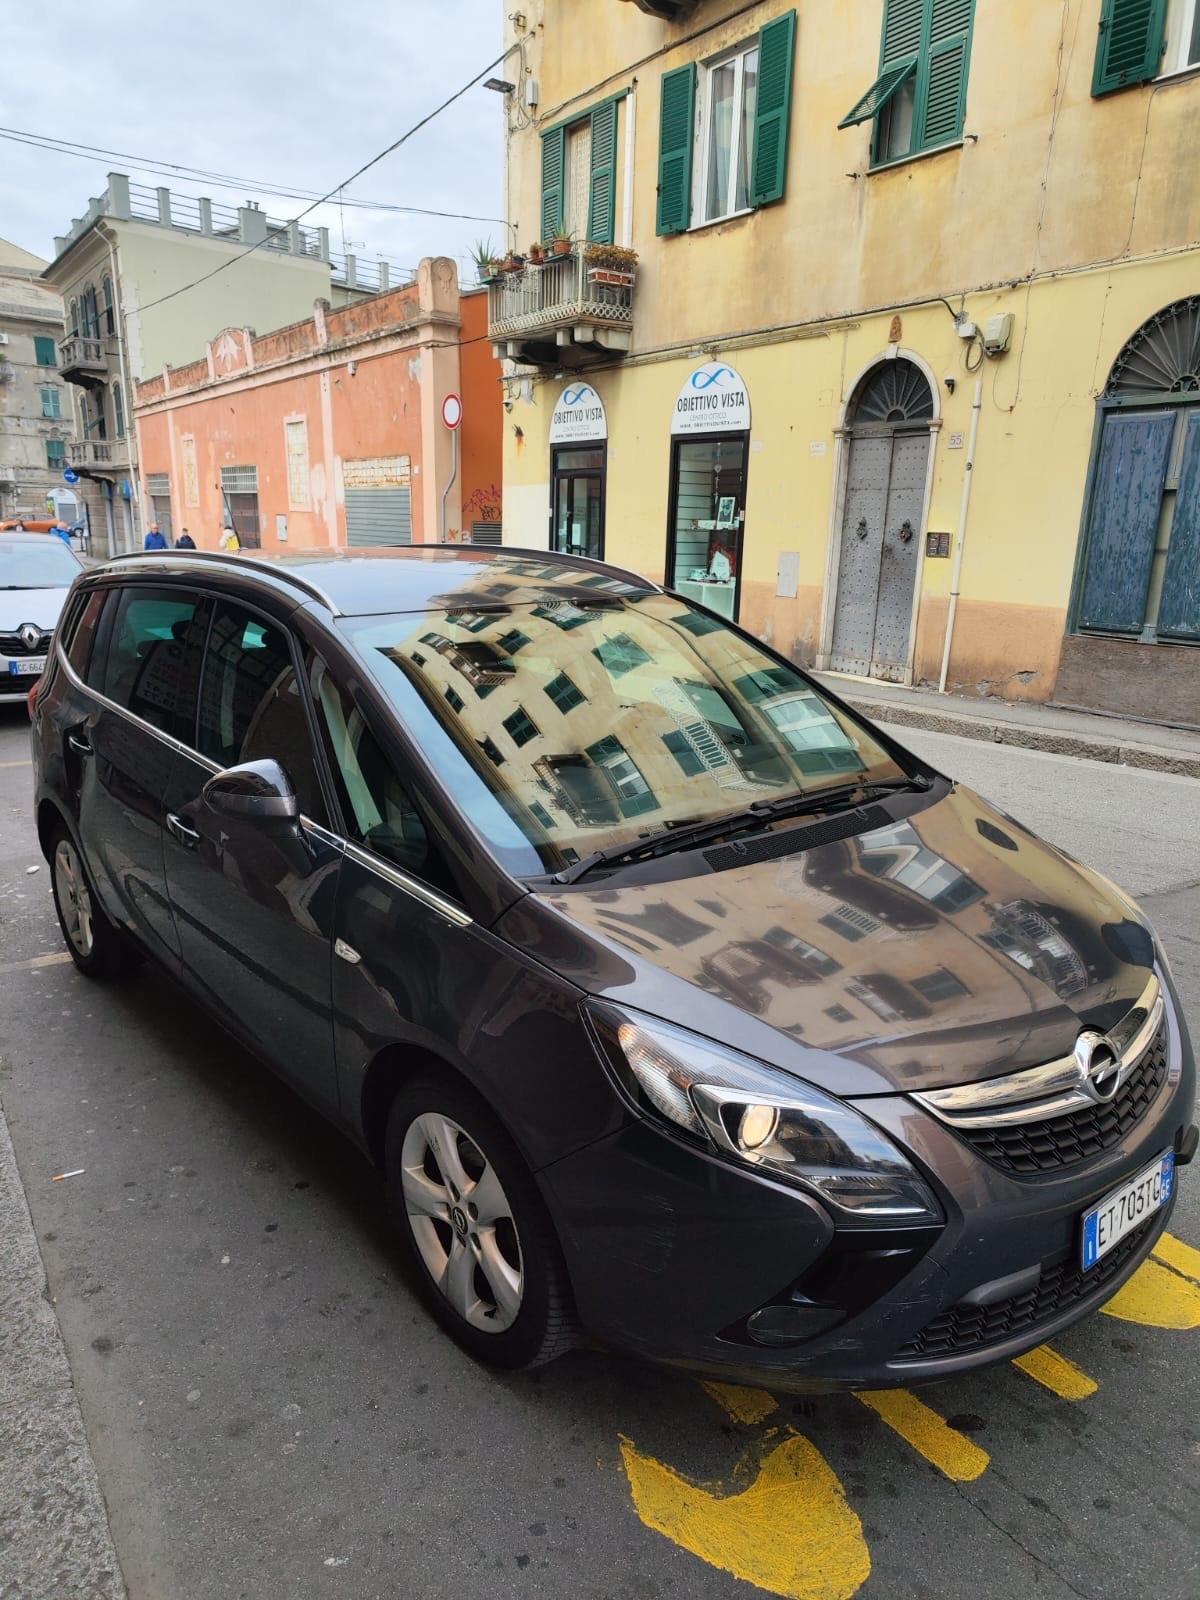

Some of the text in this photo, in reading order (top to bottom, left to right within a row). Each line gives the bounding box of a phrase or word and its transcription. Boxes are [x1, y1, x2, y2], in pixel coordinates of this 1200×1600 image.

[677, 391, 745, 413] OBIETTIVO VISTA
[553, 407, 603, 425] OBIETTIVO VISTA
